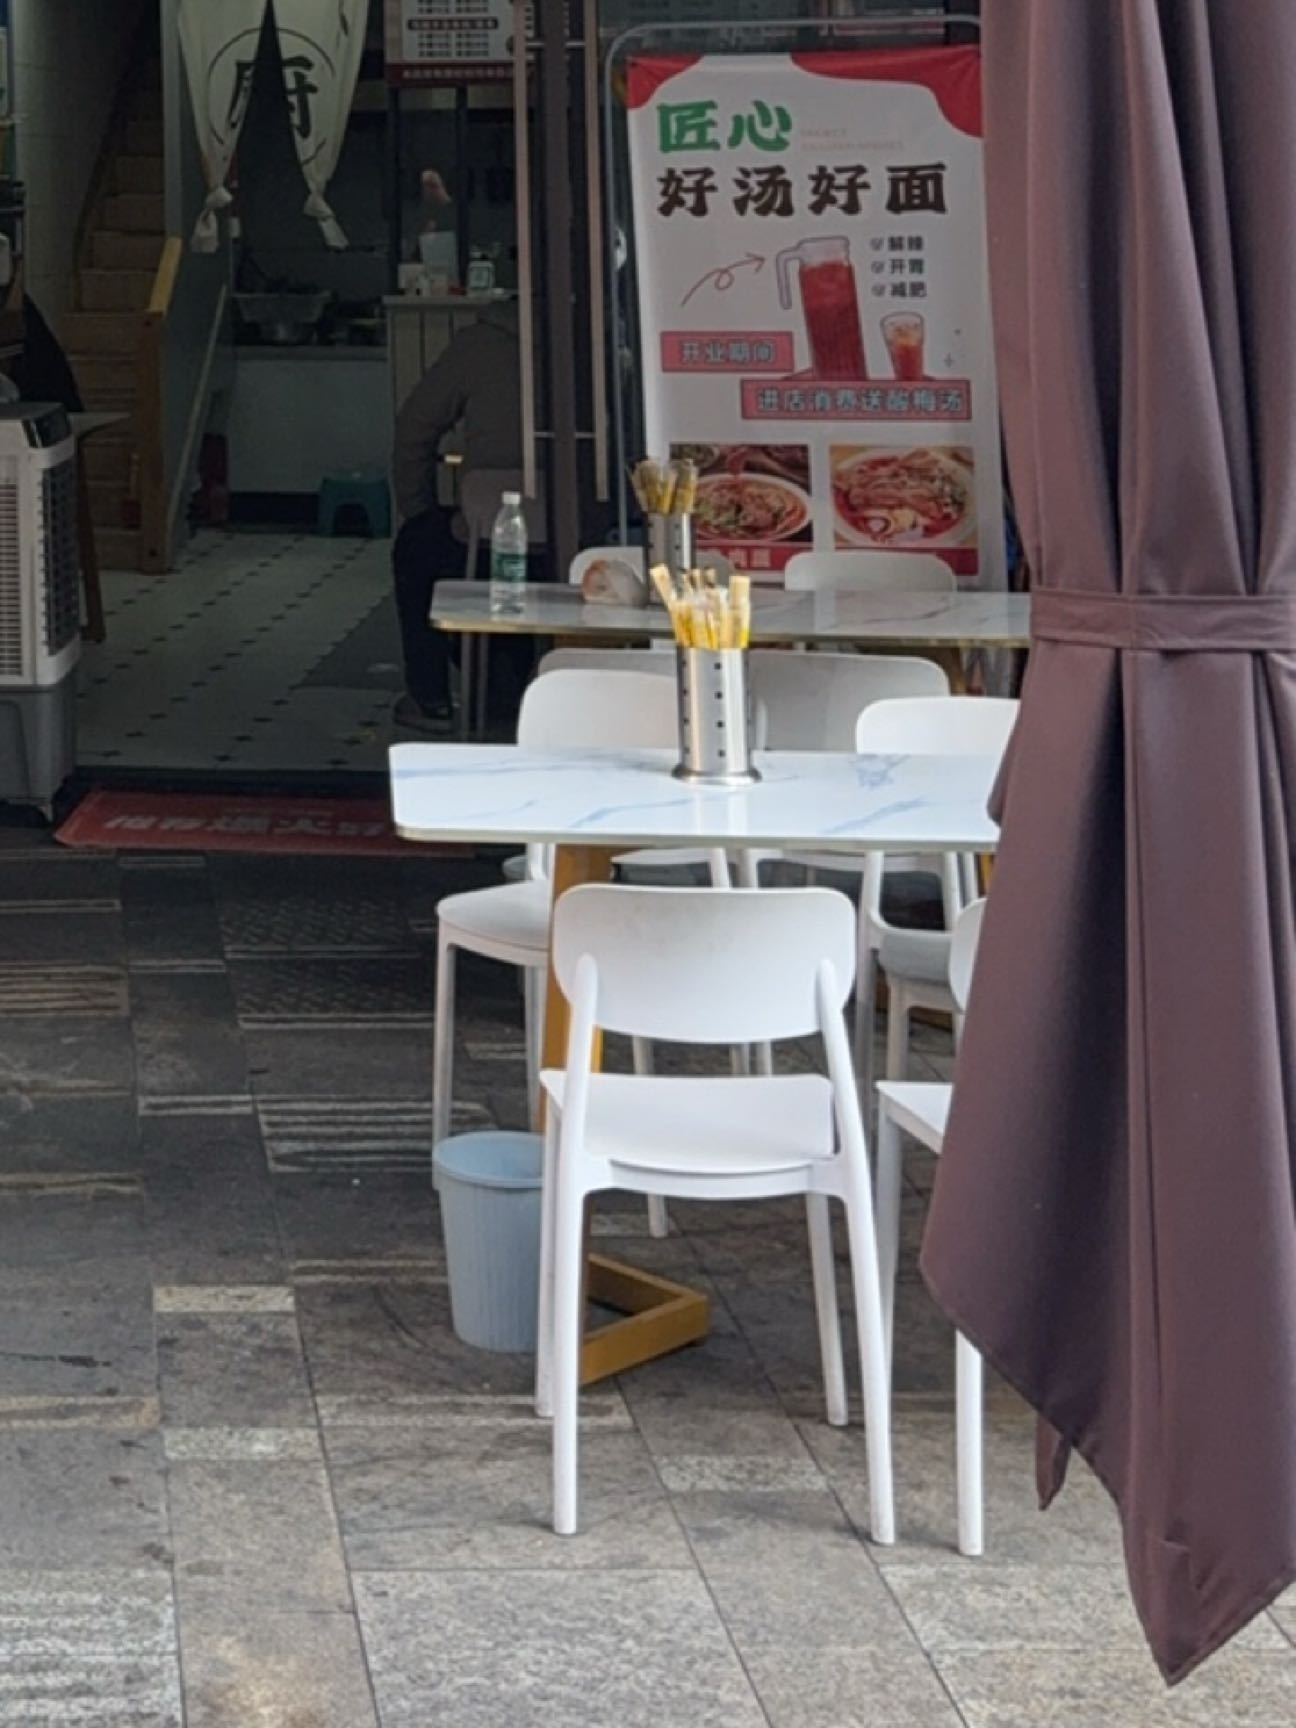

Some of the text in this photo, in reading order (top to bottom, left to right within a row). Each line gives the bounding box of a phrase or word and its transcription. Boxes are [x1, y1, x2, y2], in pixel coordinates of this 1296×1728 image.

[657, 99, 793, 152] 匠心
[657, 161, 947, 217] 好汤好面
[680, 340, 775, 365] 开业期间
[757, 388, 962, 414] 进店消费送酸梅汤
